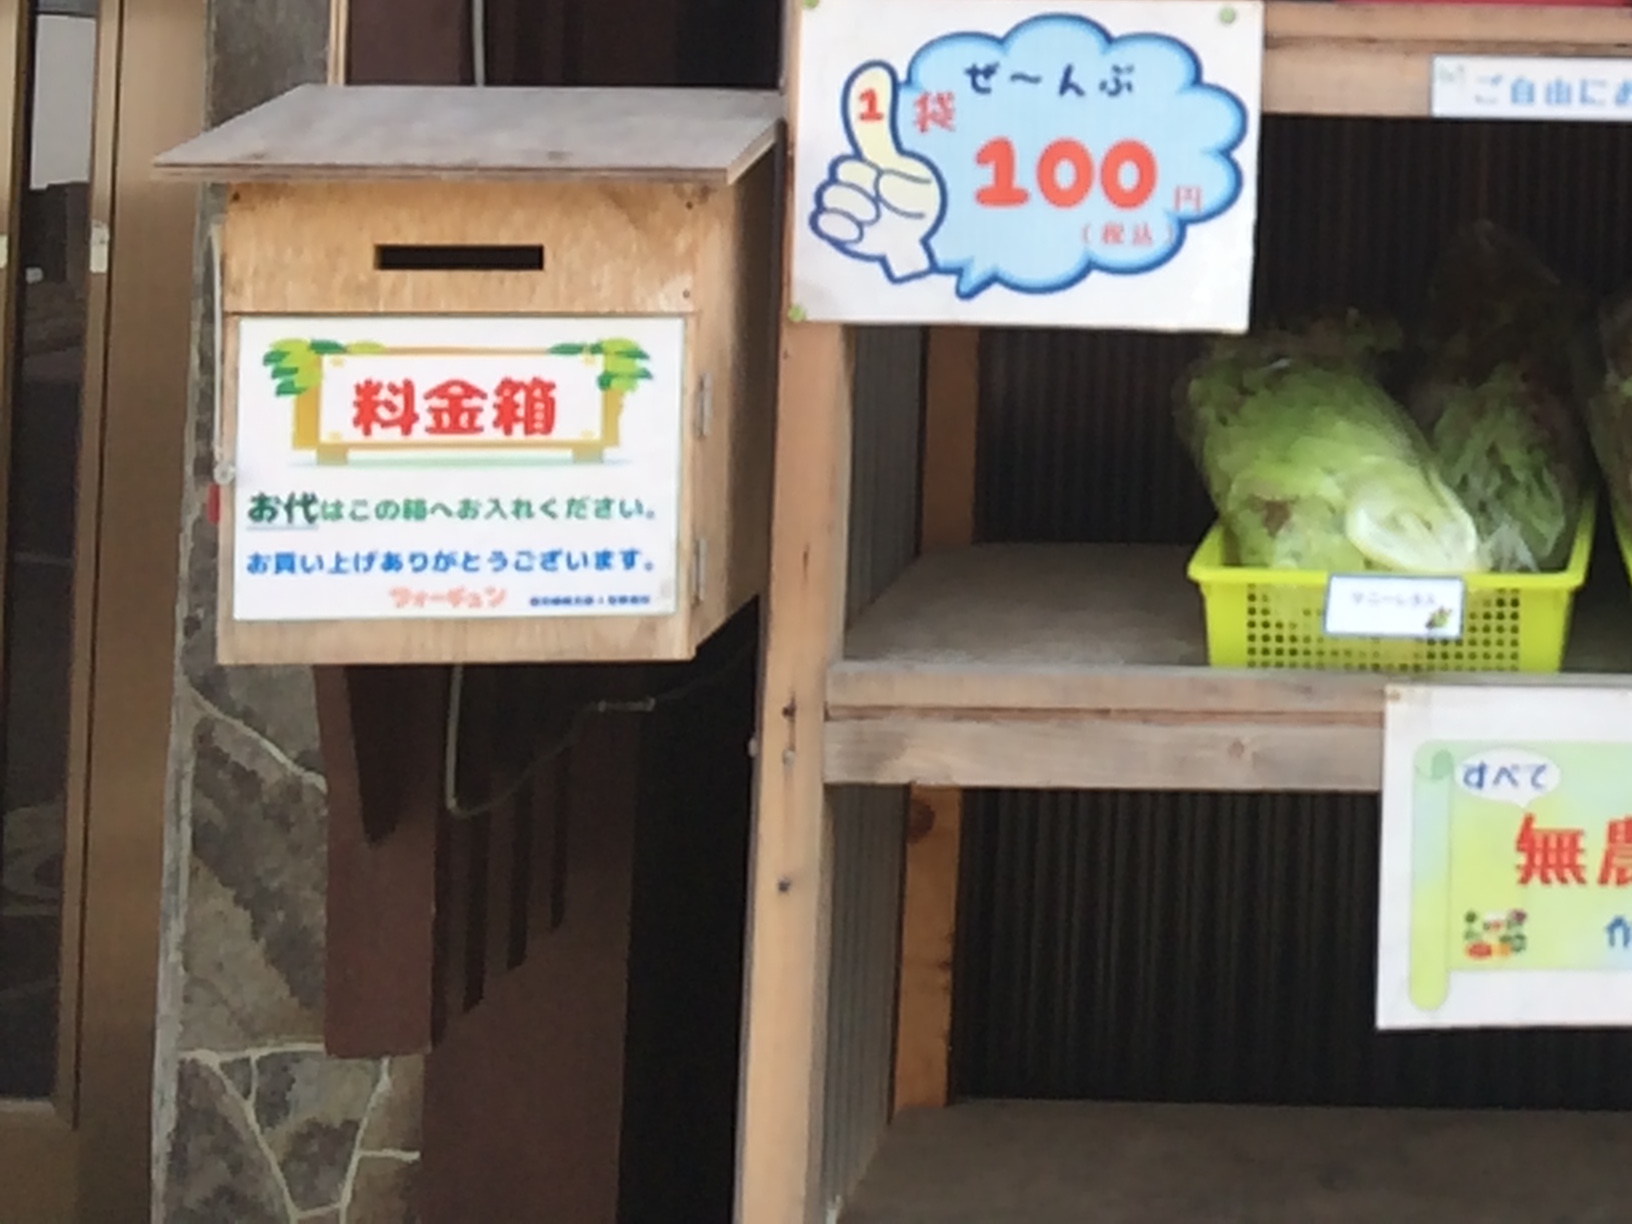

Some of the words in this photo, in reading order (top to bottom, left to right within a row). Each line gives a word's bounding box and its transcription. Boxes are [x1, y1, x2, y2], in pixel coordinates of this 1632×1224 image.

[973, 135, 1203, 213] 100円
[351, 376, 558, 437] 料金箱
[246, 491, 656, 526] お代はこの箱へお入れください。
[246, 549, 655, 577] お買い上げありがとうございます。
[1462, 760, 1549, 791] すべて
